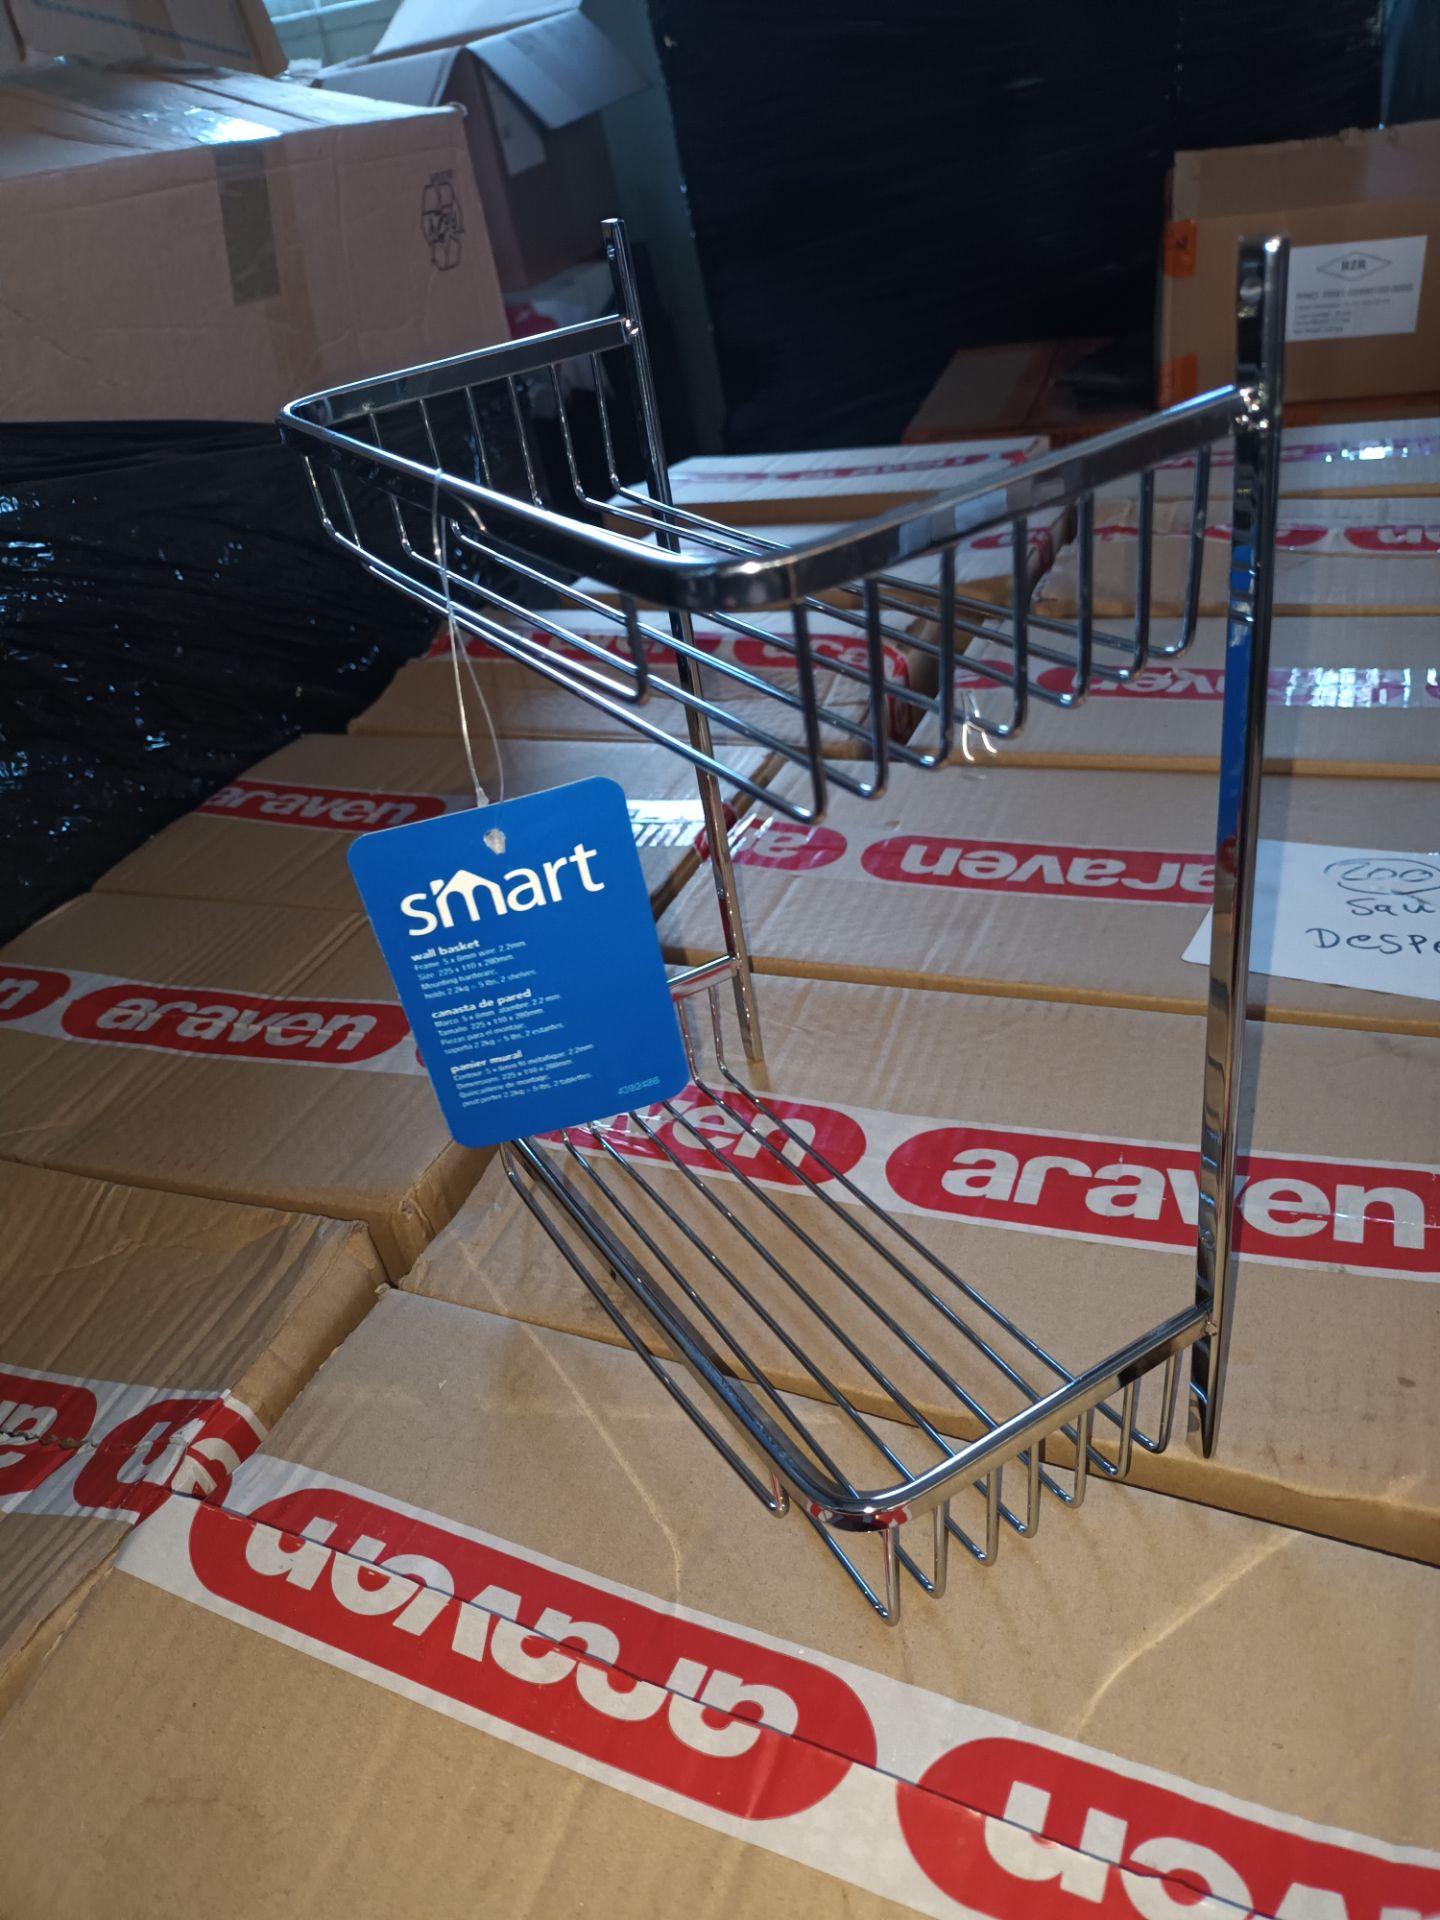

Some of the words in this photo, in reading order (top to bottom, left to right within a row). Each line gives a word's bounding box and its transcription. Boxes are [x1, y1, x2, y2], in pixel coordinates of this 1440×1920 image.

[400, 843, 605, 936] smart
[410, 948, 437, 961] wall
[437, 939, 480, 956] basket
[432, 1004, 477, 1019] canasta
[478, 999, 494, 1008] de
[496, 988, 532, 1006] pared
[96, 998, 378, 1051] araven
[450, 1060, 486, 1074] panier
[489, 1049, 523, 1064] mural
